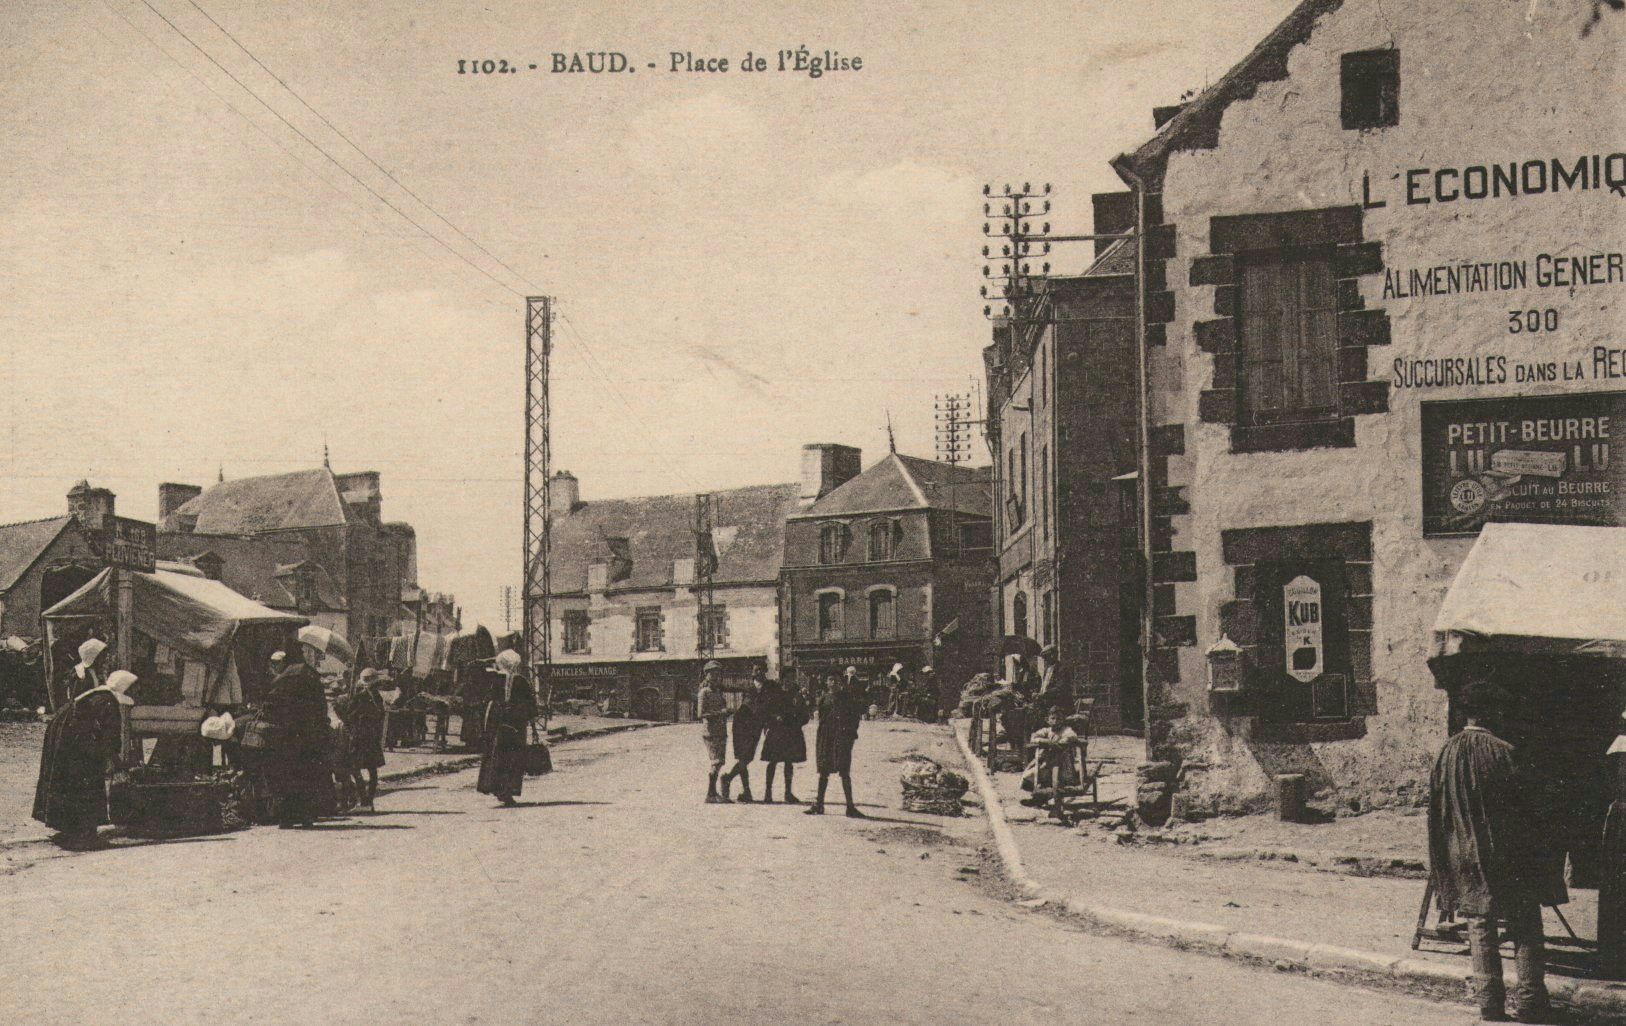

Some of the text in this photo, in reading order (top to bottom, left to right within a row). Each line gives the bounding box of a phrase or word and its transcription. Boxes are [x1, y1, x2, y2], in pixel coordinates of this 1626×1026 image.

[1382, 260, 1527, 300] ALIMENTATION
[1508, 307, 1559, 335] 300
[1393, 355, 1507, 389] SUCCURSALES
[1515, 362, 1557, 383] DANS
[1562, 361, 1584, 381] LA
[1447, 416, 1611, 445] PETIT-BEURRE
[1573, 443, 1610, 472] LU
[1558, 481, 1611, 495] BEURRE
[1555, 498, 1567, 508] 24
[1288, 600, 1320, 627] KUB
